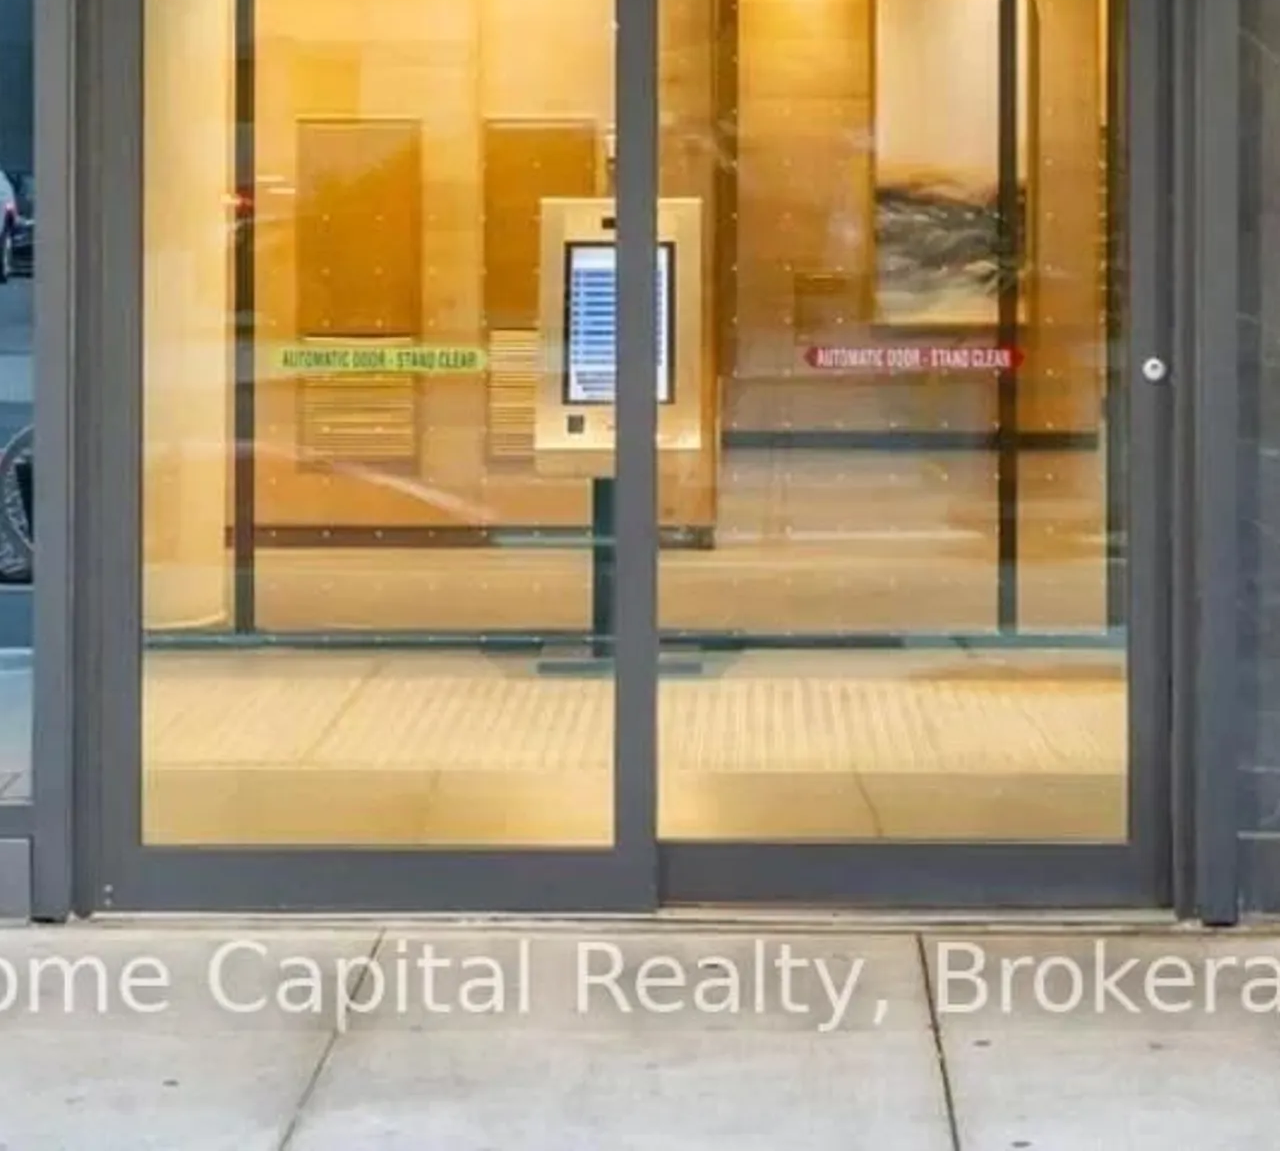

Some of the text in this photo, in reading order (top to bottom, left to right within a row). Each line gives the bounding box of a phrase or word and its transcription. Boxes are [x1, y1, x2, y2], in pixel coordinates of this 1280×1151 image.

[282, 349, 349, 367] AUTOMATIC
[352, 349, 385, 368] DOOR
[397, 350, 433, 368] STAND
[438, 349, 477, 368] CLEAR
[817, 347, 882, 366] AUTOMATIC
[886, 348, 920, 366] DOOR
[931, 348, 968, 367] STAND
[971, 349, 1011, 367] CLEAR
